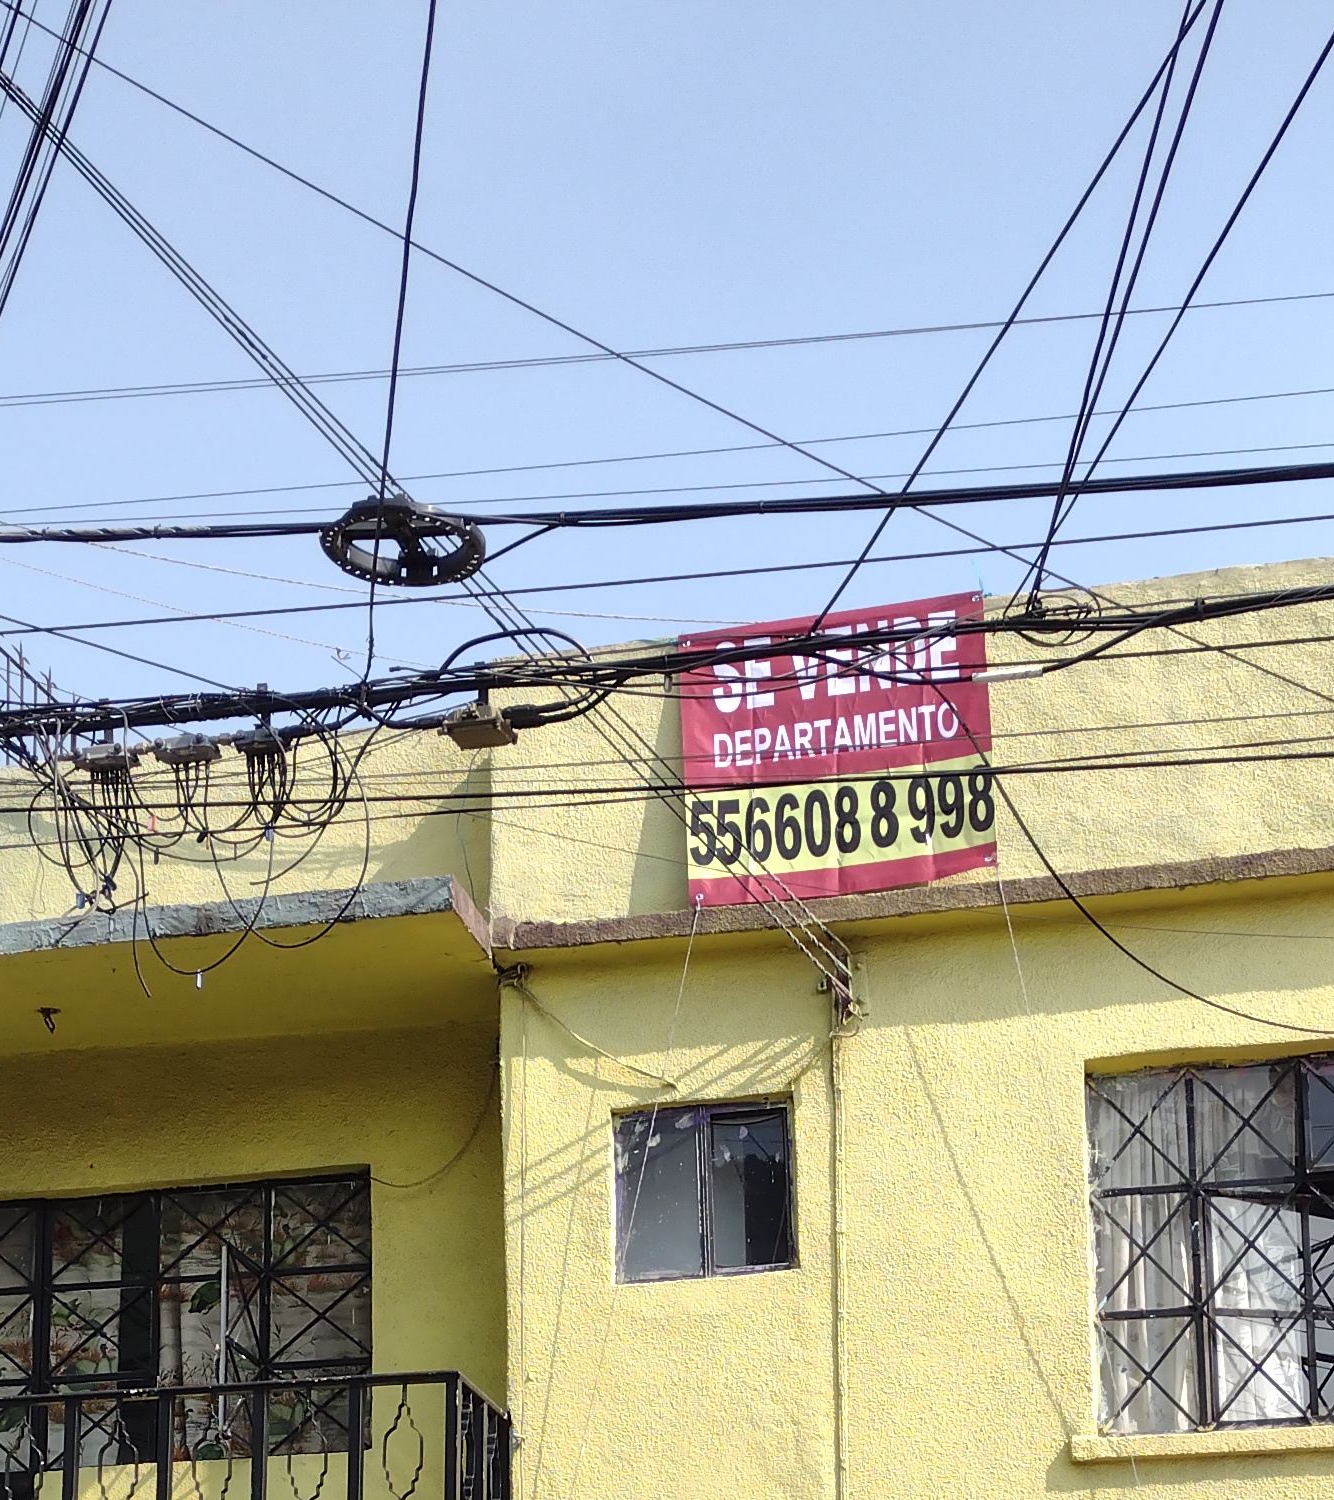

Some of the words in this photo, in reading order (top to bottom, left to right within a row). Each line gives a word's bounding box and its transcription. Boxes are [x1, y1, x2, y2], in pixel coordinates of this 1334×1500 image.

[711, 637, 776, 715] SE
[792, 609, 961, 702] VENDE
[713, 700, 960, 770] DEPARTAMENTO
